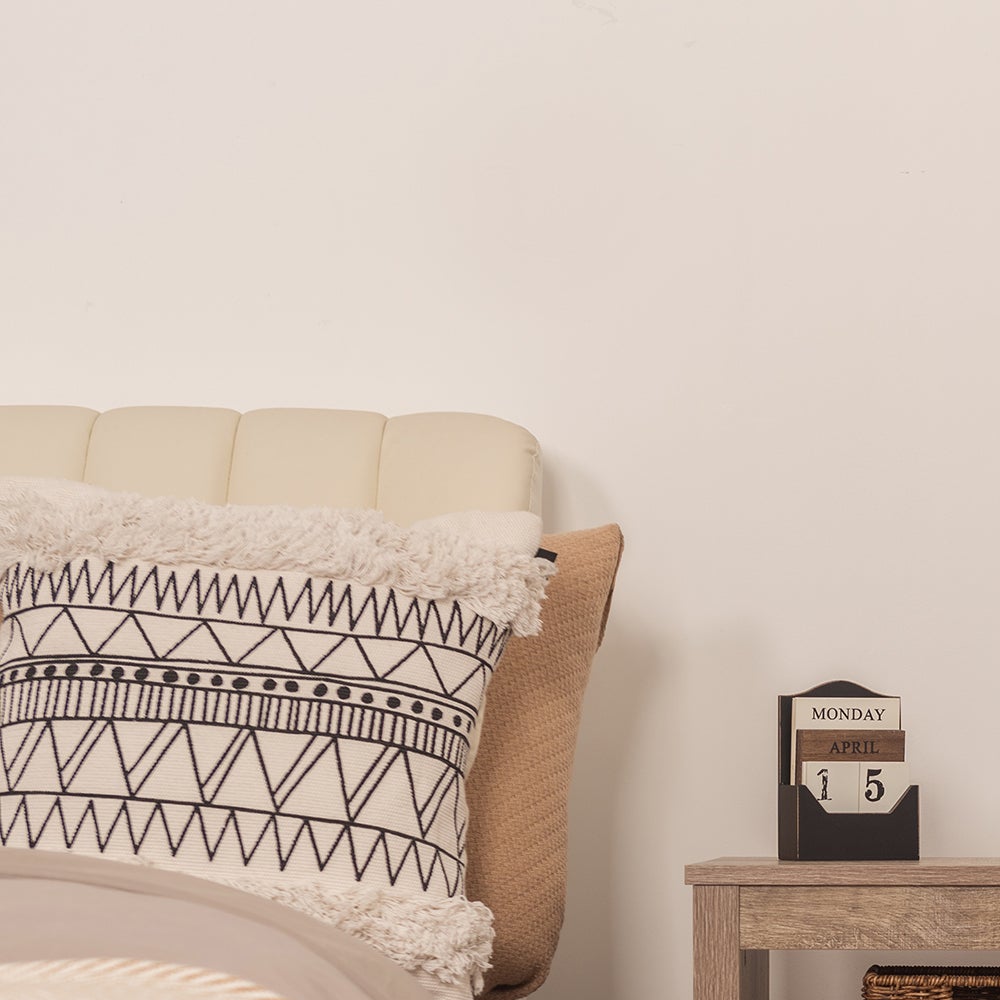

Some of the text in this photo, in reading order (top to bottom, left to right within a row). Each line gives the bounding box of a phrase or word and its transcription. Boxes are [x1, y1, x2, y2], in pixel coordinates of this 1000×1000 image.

[812, 708, 886, 721] MONDAY
[829, 741, 879, 754] APRIL
[865, 769, 885, 802] 5
